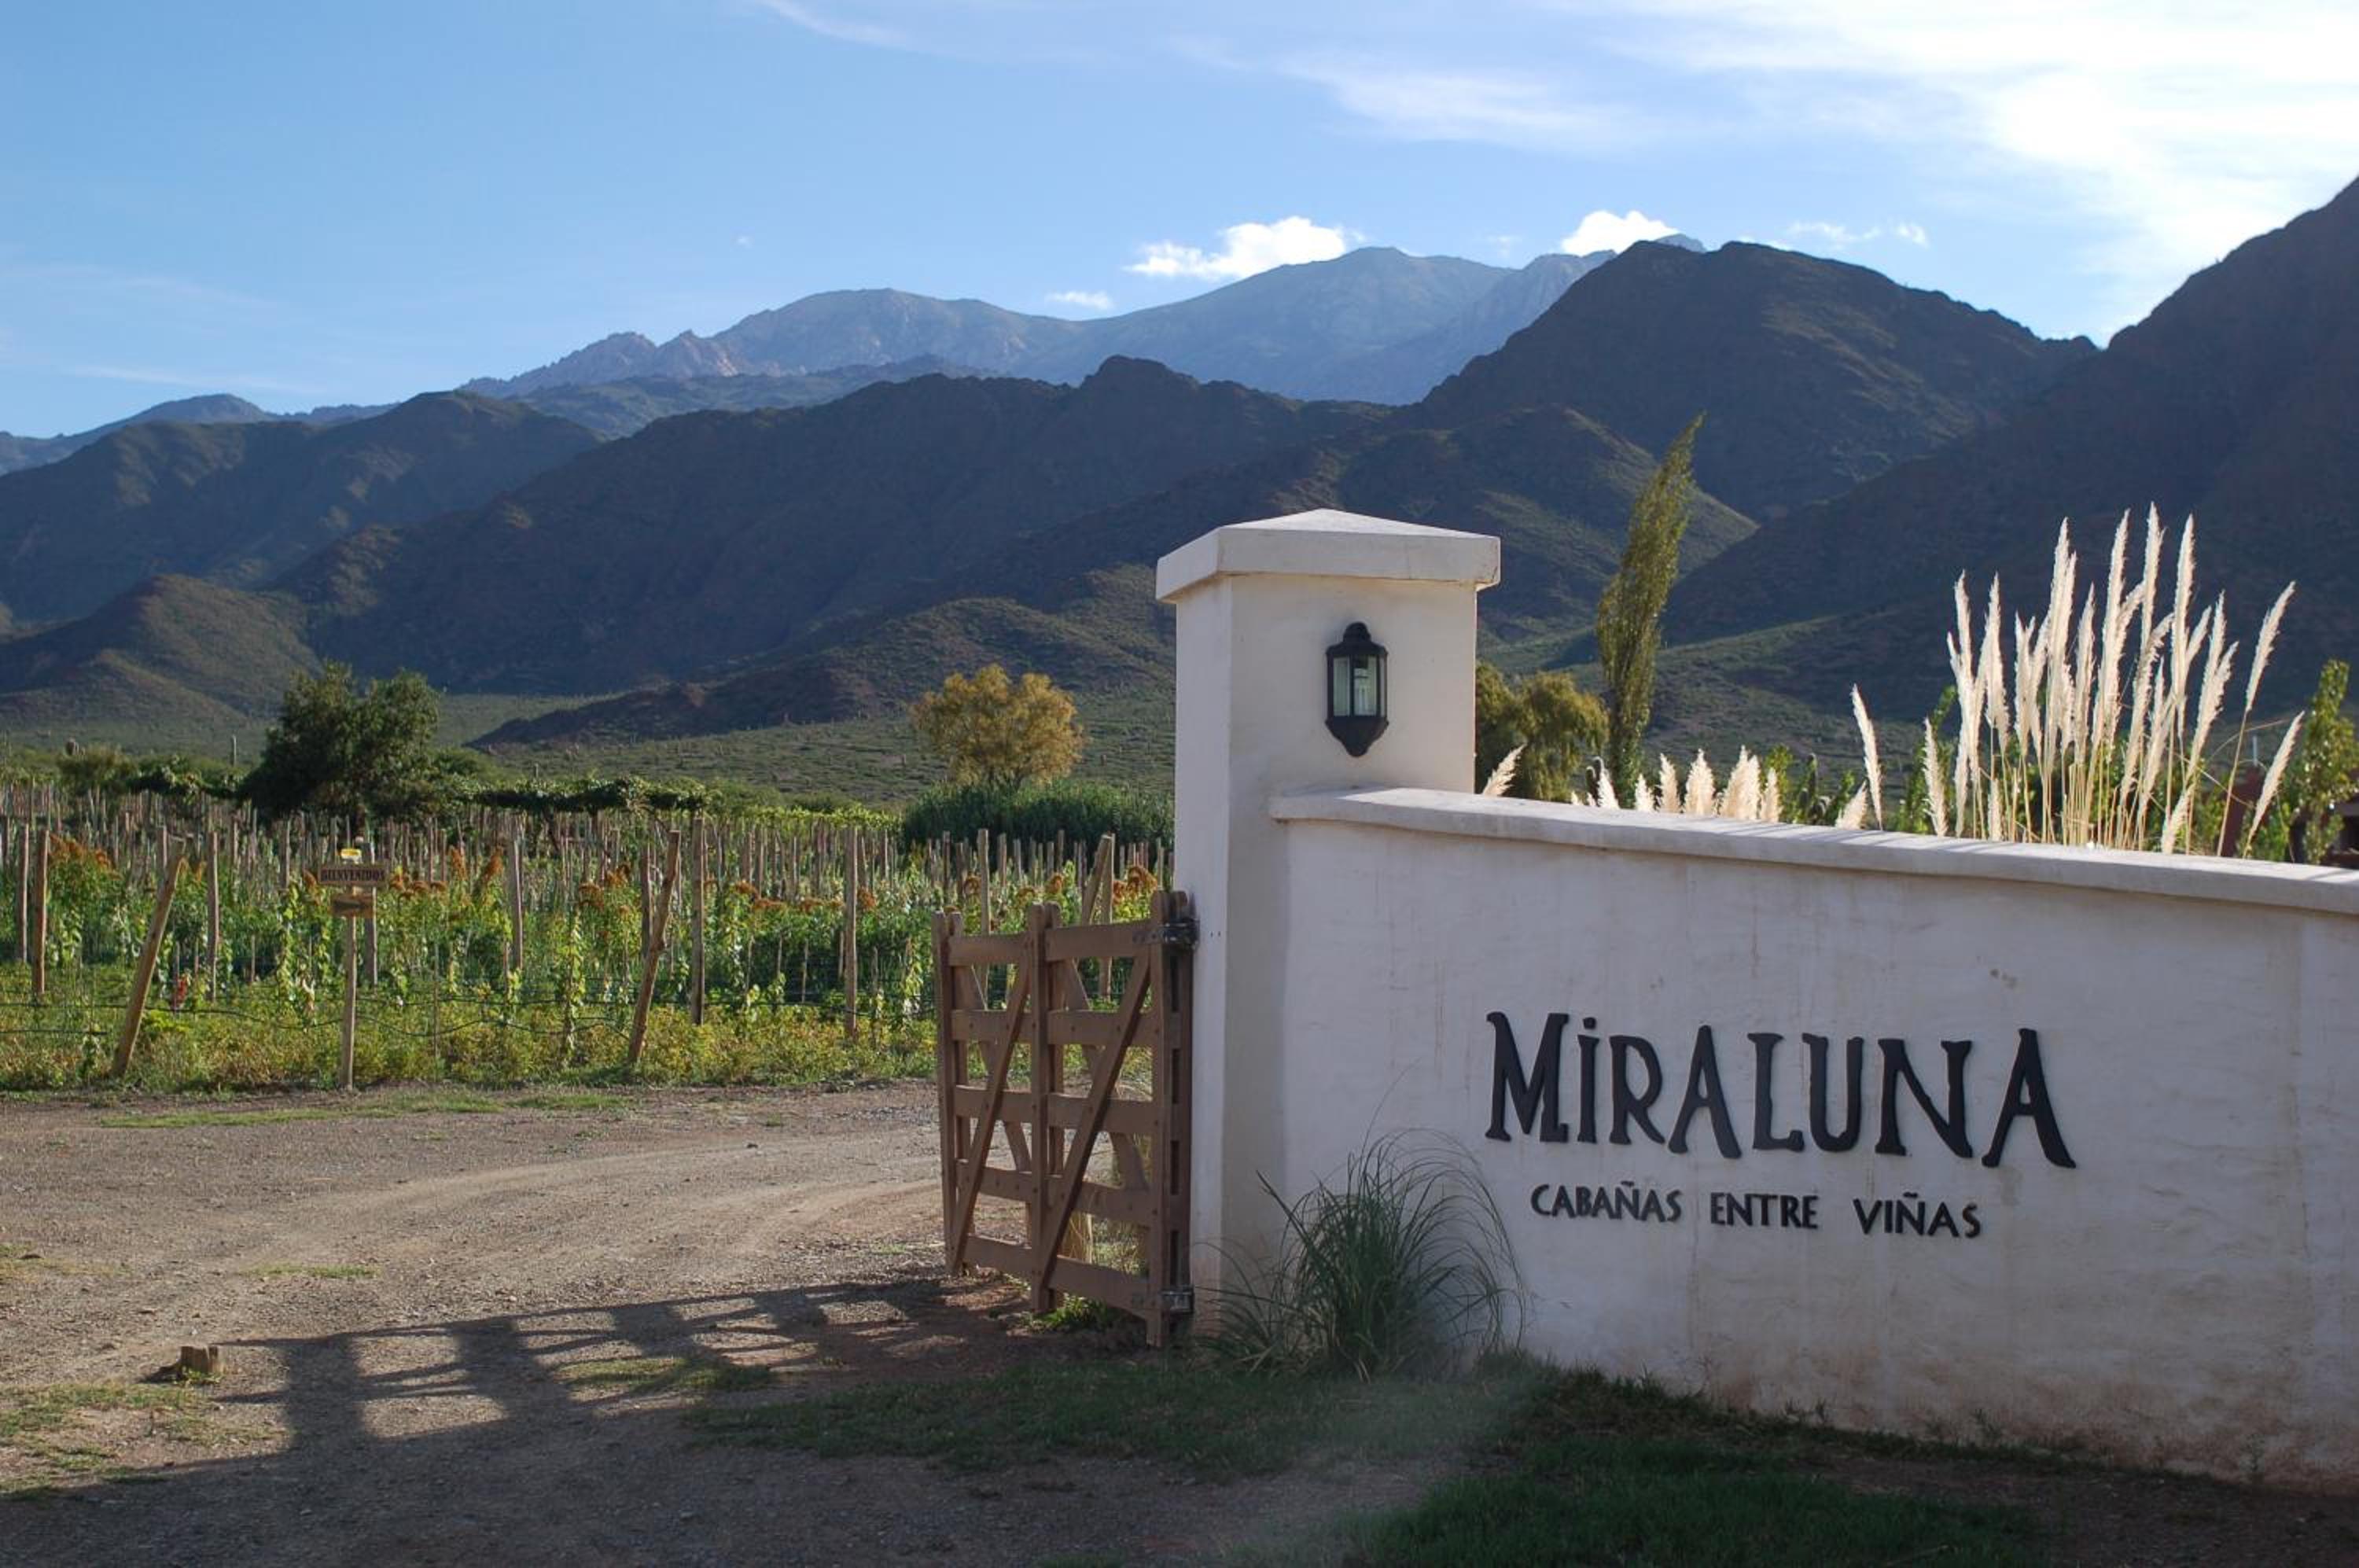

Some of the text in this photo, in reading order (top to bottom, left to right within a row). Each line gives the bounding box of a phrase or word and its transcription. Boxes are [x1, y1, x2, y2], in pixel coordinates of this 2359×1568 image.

[1530, 1181, 1982, 1239] CABAÑAS ENTRE VIÑAS
